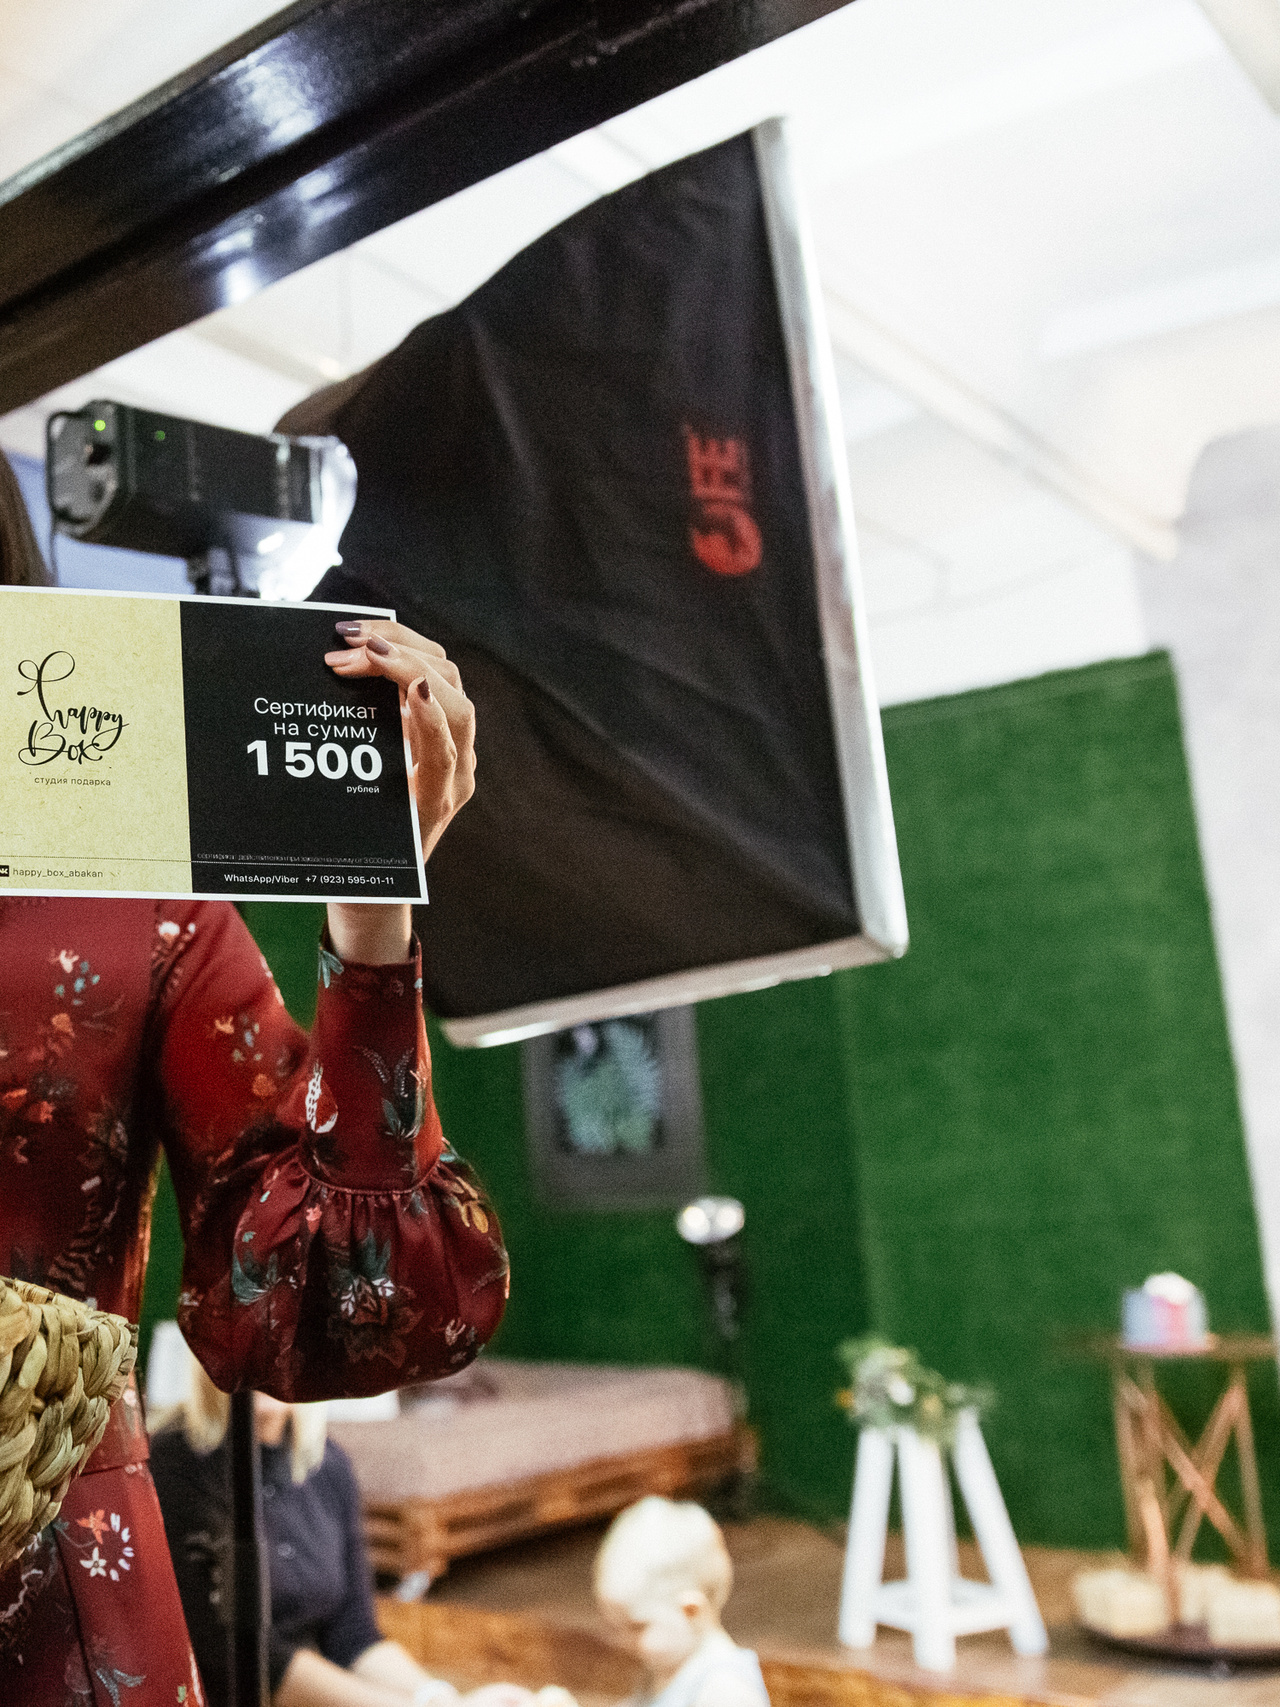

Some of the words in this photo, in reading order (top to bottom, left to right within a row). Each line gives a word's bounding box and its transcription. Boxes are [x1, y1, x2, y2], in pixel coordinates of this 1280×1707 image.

[254, 697, 377, 721] Сертификат
[274, 722, 299, 736] на
[307, 723, 378, 743] сумму
[18, 720, 103, 766] Box
[34, 776, 68, 786] студия
[70, 777, 112, 787] подарка
[346, 785, 380, 794] рублей
[12, 866, 104, 878] happy_box_abakan
[224, 874, 299, 884] WhatsApp/Viber
[306, 875, 317, 883] +7
[320, 875, 345, 885] (923)
[347, 876, 395, 885] 595-01-11
